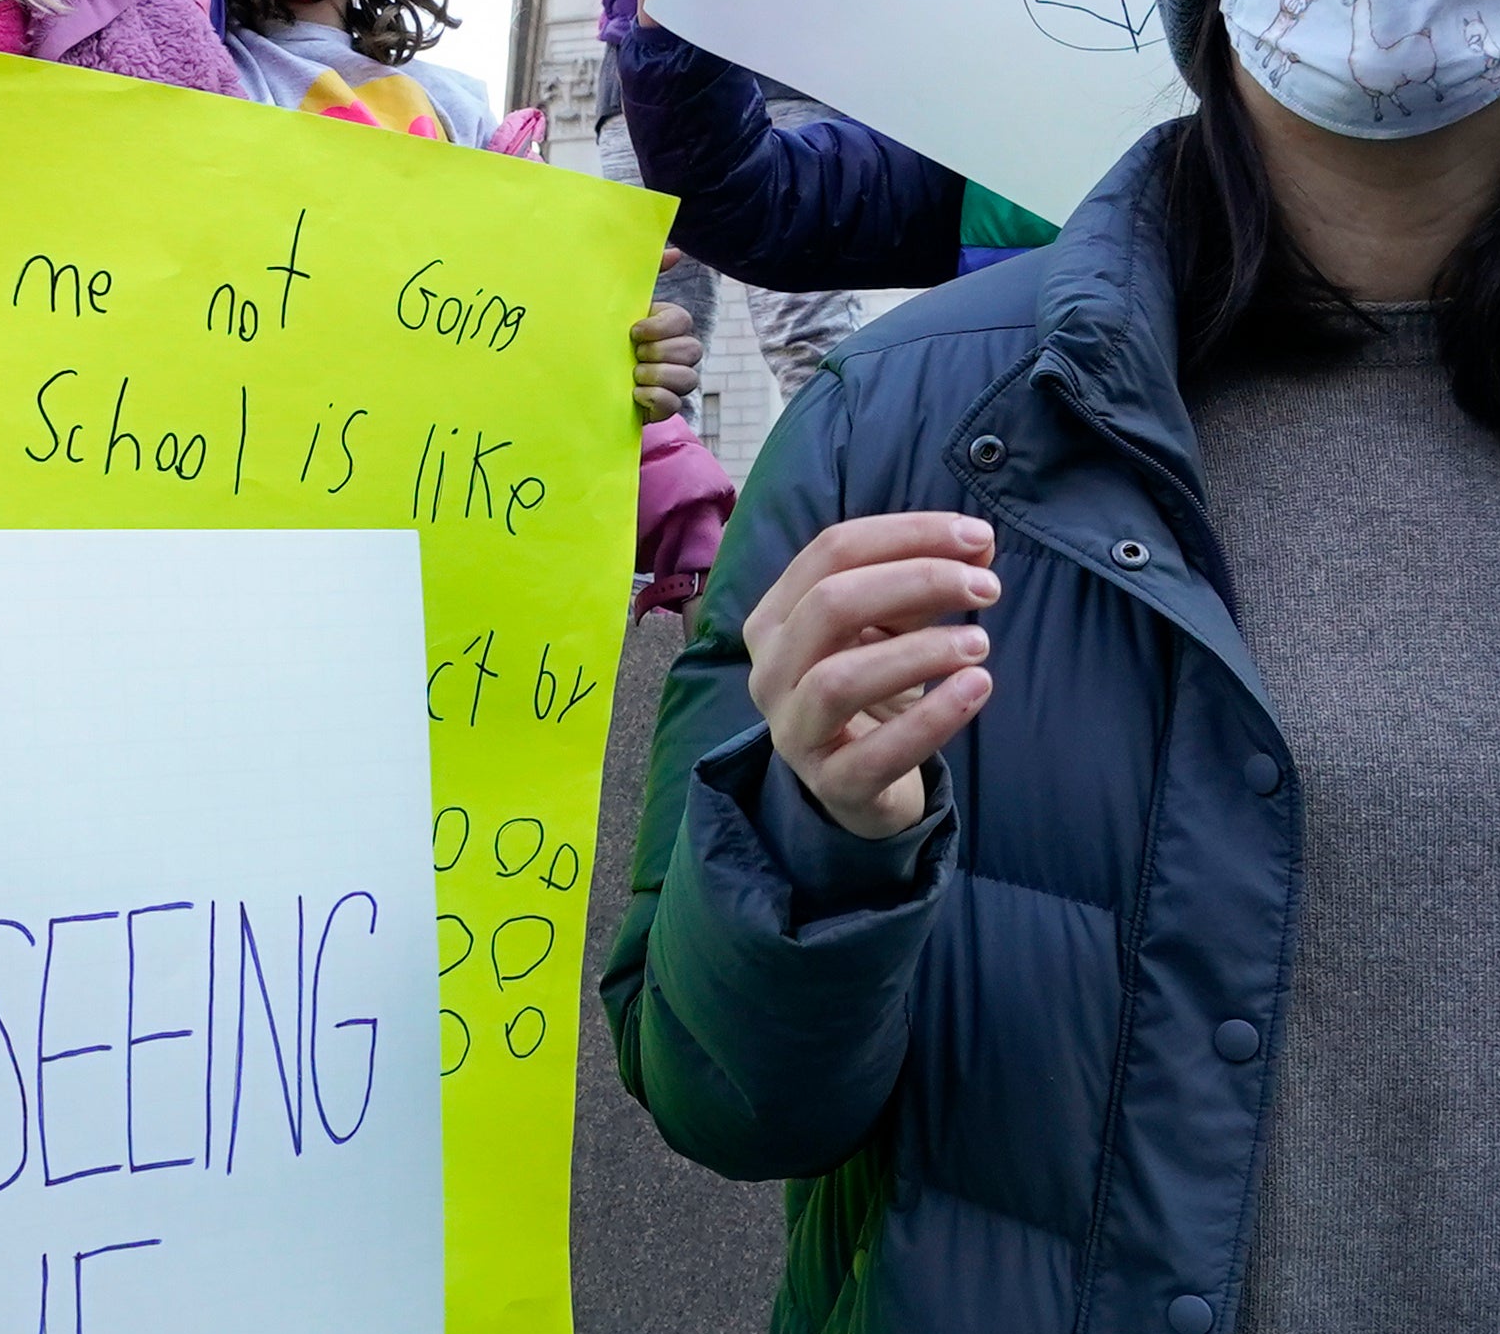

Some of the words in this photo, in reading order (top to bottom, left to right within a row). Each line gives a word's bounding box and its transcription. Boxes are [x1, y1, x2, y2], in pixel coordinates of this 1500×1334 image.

[14, 255, 112, 317] me
[208, 209, 311, 342] not
[302, 402, 367, 493] is
[534, 643, 597, 723] by
